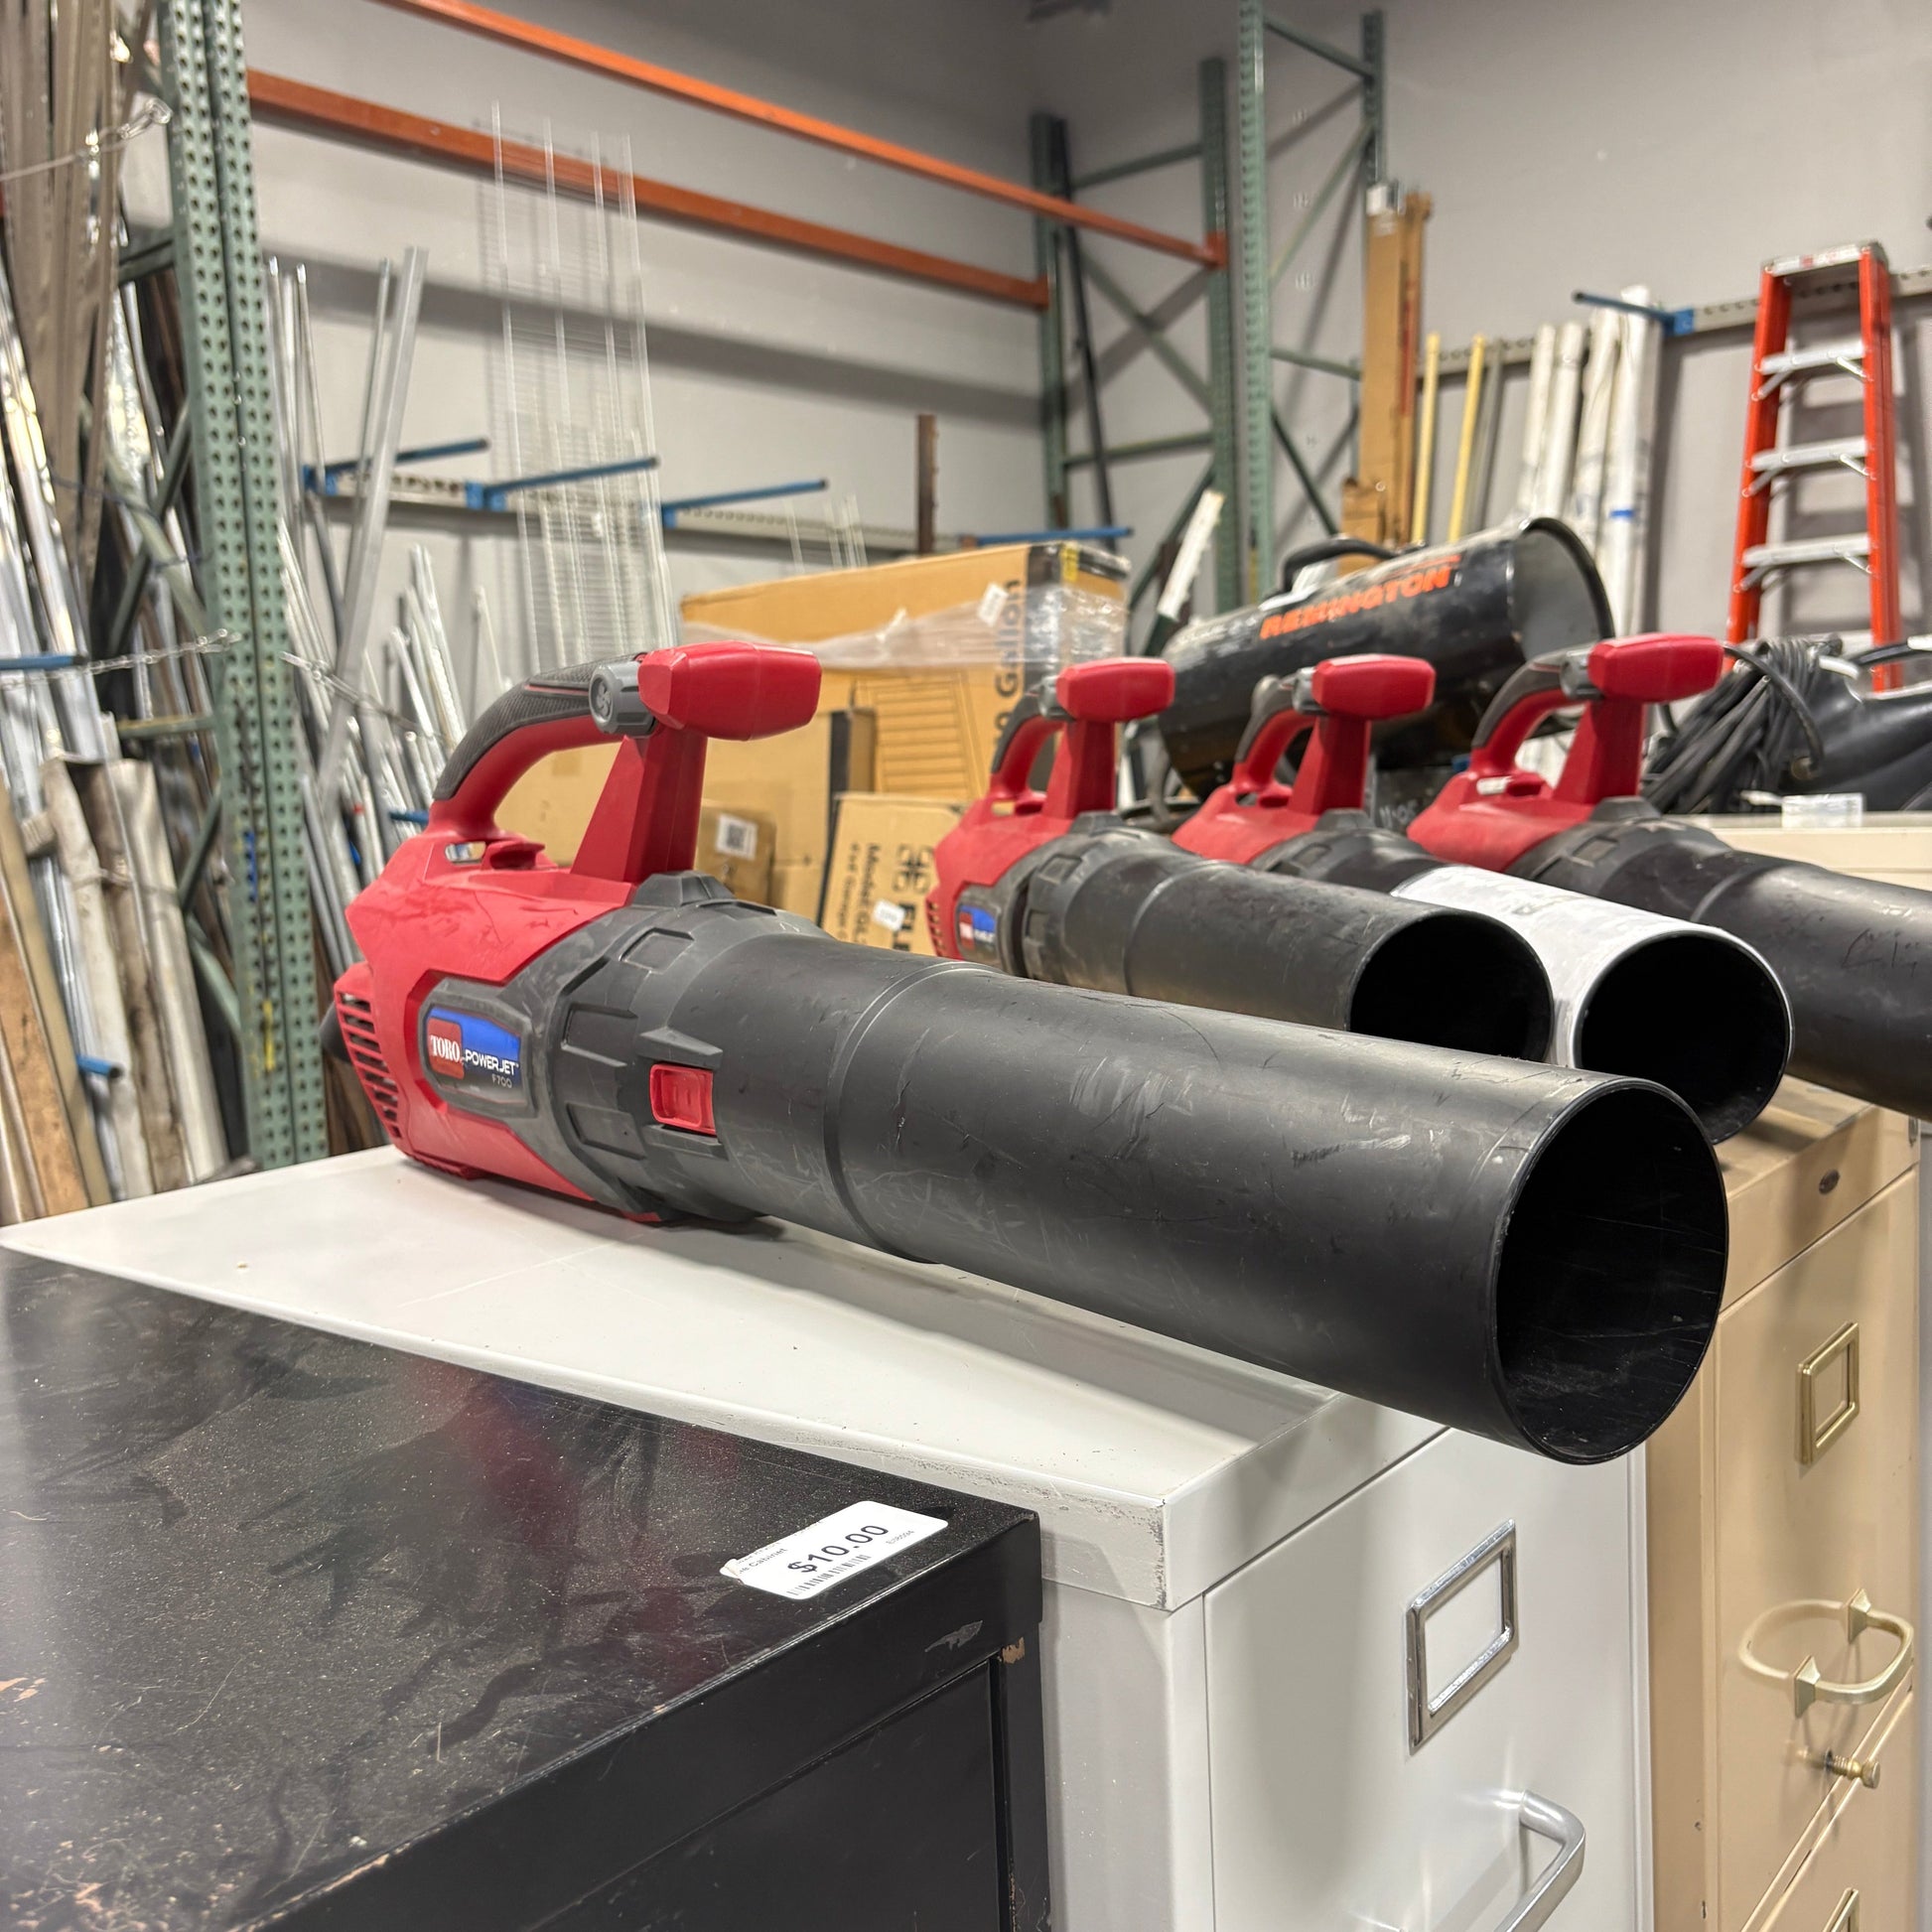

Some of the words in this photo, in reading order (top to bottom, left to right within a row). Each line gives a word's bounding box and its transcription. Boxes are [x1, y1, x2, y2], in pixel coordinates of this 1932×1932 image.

[1259, 565, 1452, 640] REMINGTON
[994, 579, 1022, 698] Gallon
[430, 1034, 461, 1064] TORO
[465, 1048, 517, 1076] POWERJET
[491, 1073, 513, 1089] F700
[787, 1525, 889, 1574] $10.00
